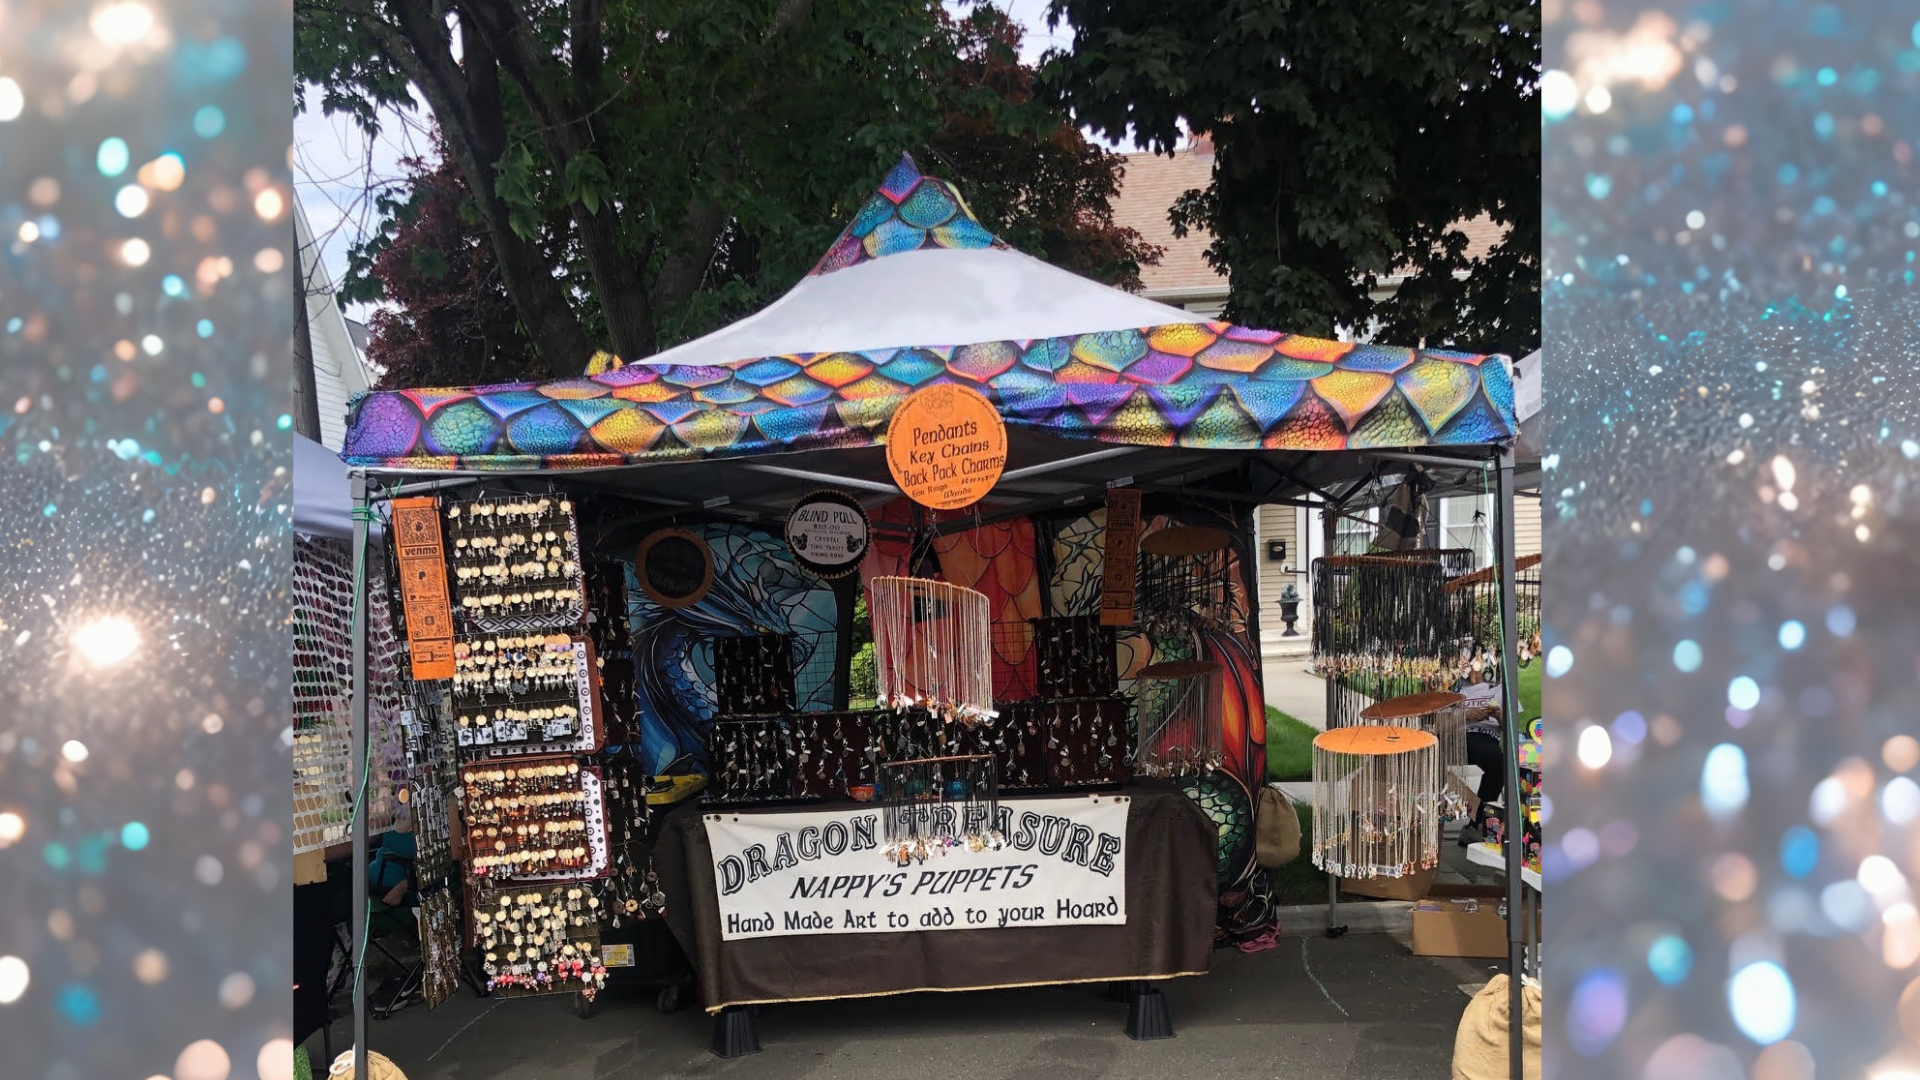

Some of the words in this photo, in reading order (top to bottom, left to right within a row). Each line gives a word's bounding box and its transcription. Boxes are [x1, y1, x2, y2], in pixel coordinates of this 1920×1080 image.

[913, 421, 978, 446] Pendants
[910, 450, 935, 465] Key
[941, 439, 989, 460] Chains
[903, 468, 928, 488] Back
[932, 462, 957, 482] Pack
[961, 454, 1005, 475] Charms
[798, 510, 828, 522] BLIND
[833, 511, 857, 525] PULL
[404, 546, 438, 556] venmo
[717, 815, 878, 896] DRAGON
[789, 872, 907, 899] NAPPY'S
[910, 864, 1039, 895] PUPPETS
[727, 912, 775, 934] Hand
[783, 910, 834, 931] Made
[843, 909, 878, 929] Art
[886, 910, 909, 928] to
[919, 907, 955, 926] add
[965, 907, 988, 925] to
[999, 906, 1045, 927] your
[1056, 896, 1120, 920] Hoard
